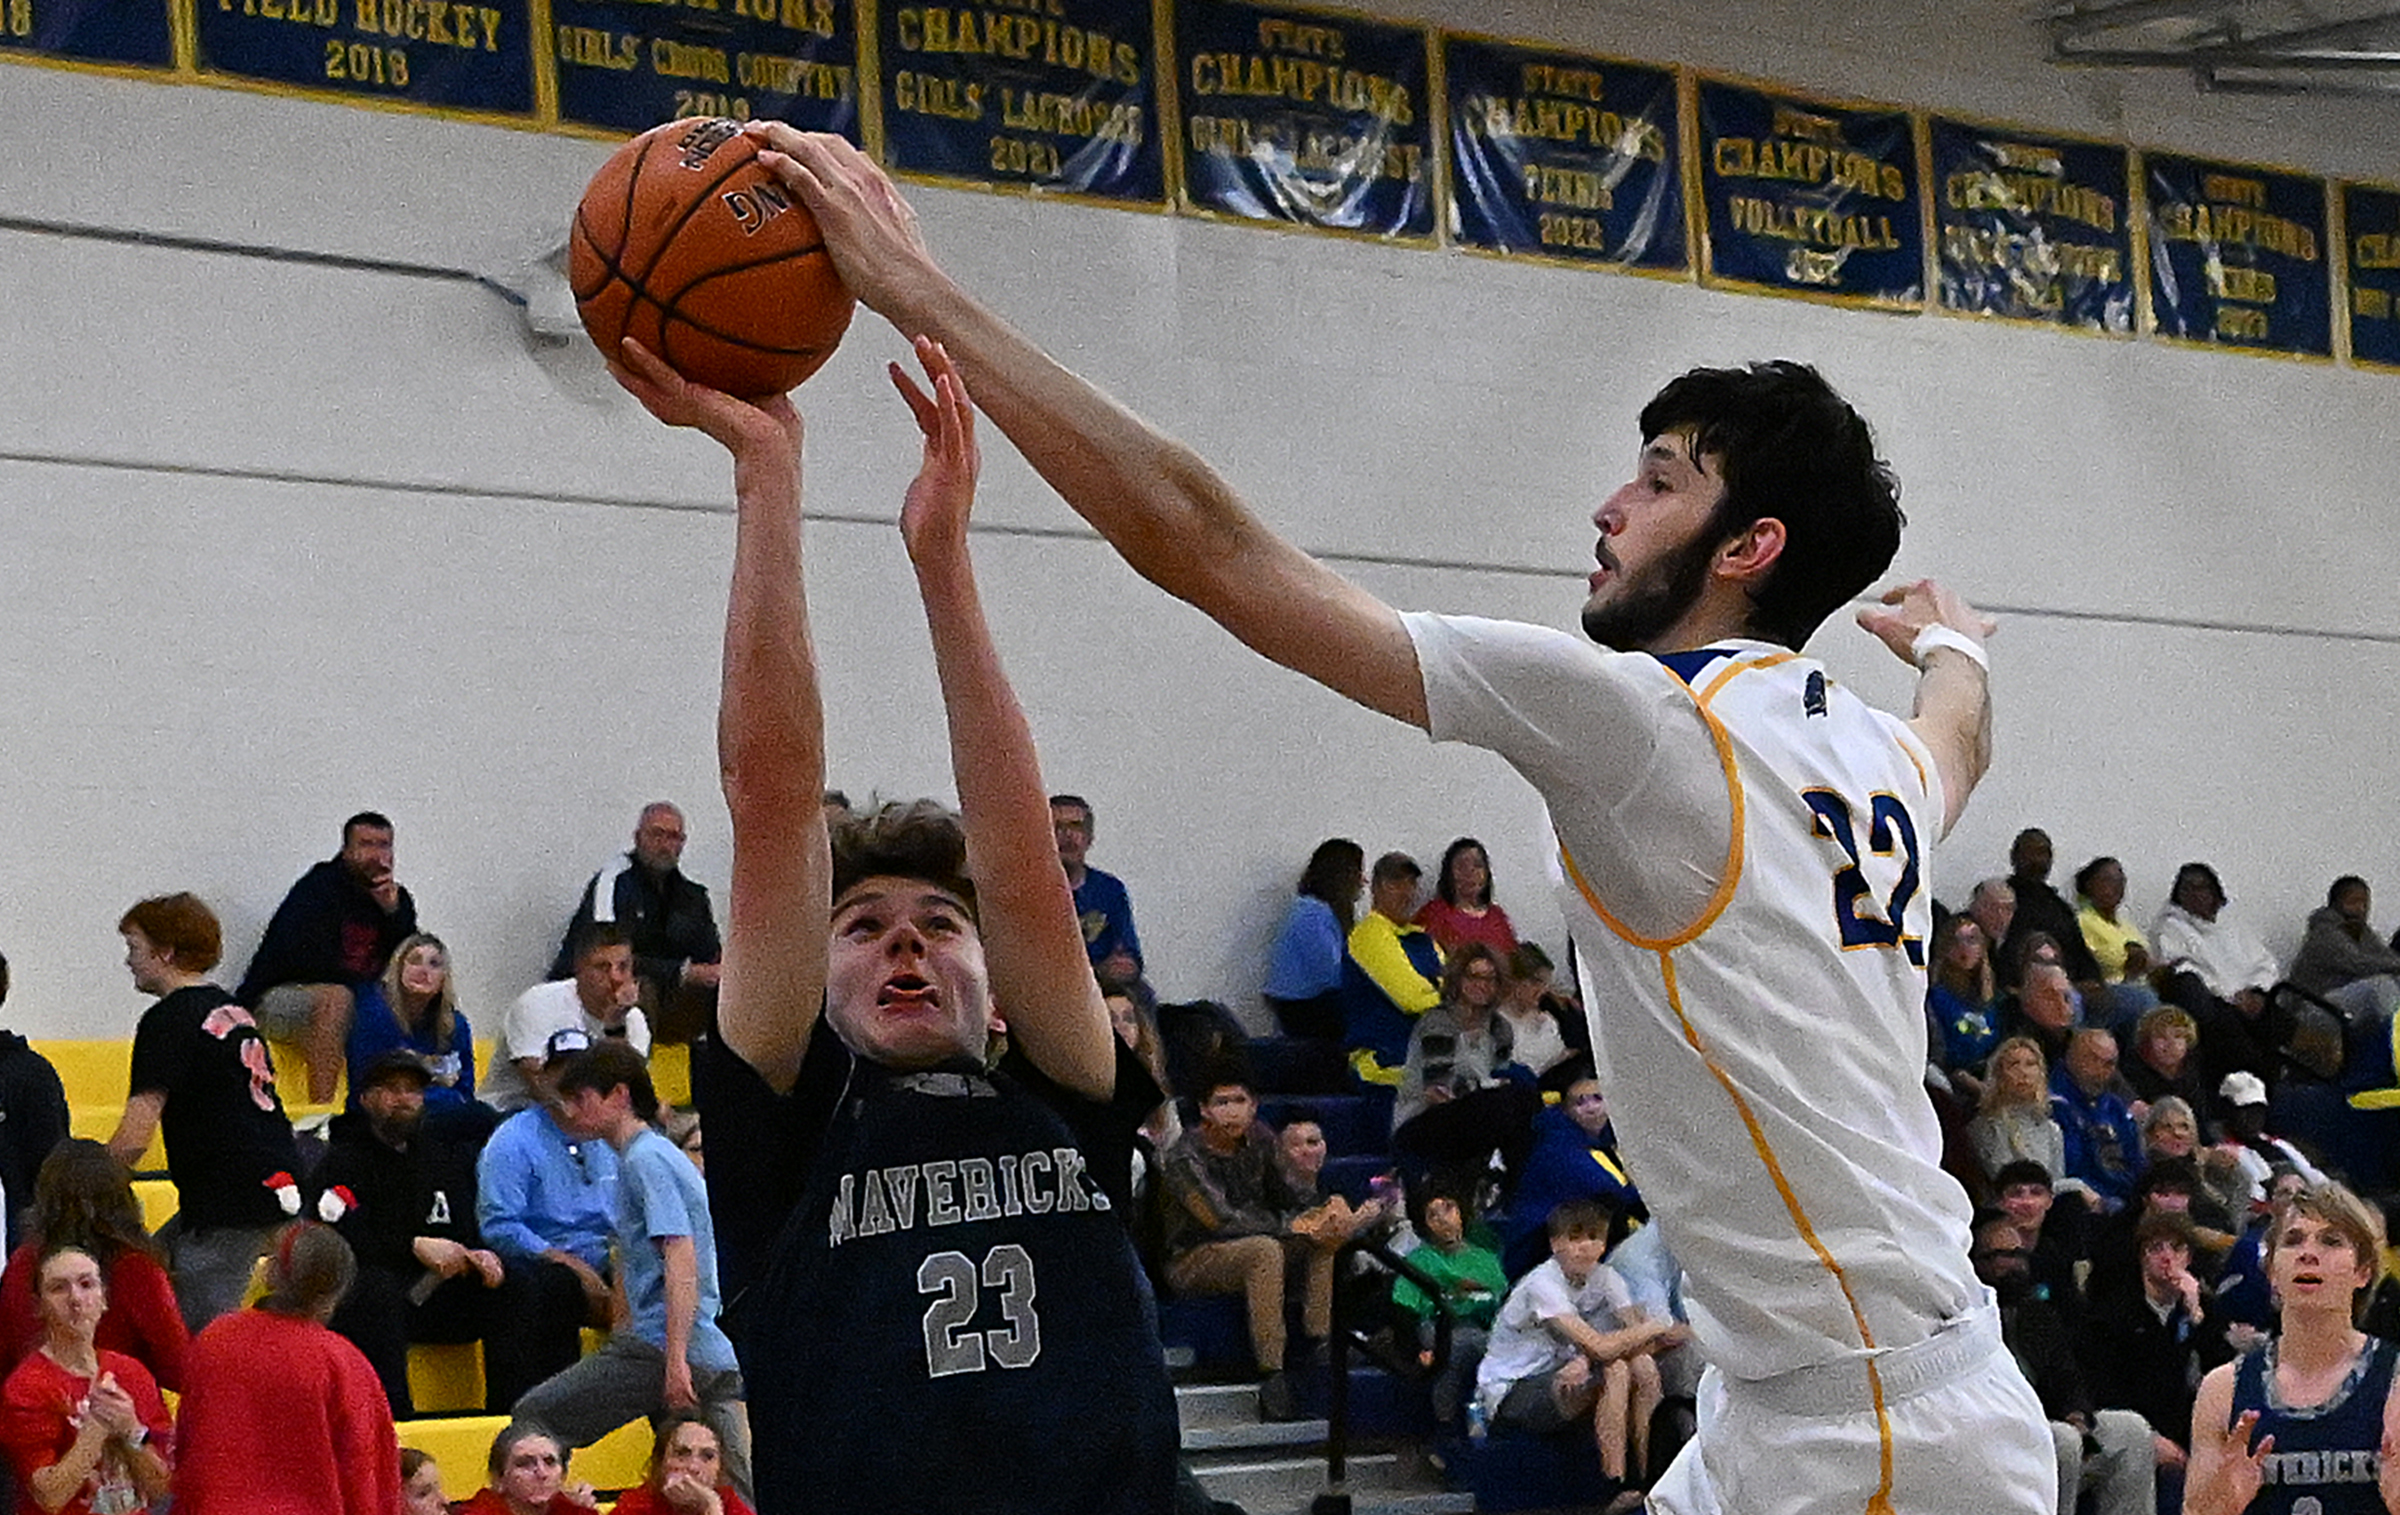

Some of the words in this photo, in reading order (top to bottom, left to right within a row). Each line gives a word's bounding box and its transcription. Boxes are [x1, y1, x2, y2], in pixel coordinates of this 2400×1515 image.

[355, 0, 501, 50] HOCKEY
[898, 7, 1140, 86] CHAMPIONS
[325, 40, 409, 86] 2018
[1192, 54, 1414, 125] CHAMPIONS
[1003, 88, 1143, 145] LACROSSE
[1465, 94, 1665, 161] CHAMPIONS
[990, 136, 1063, 179] 2021
[1714, 137, 1906, 200] CHAMPIONS
[1730, 197, 1900, 248] VOLLEYBALL
[1800, 786, 1928, 970] 22
[917, 1245, 1041, 1378] 23
